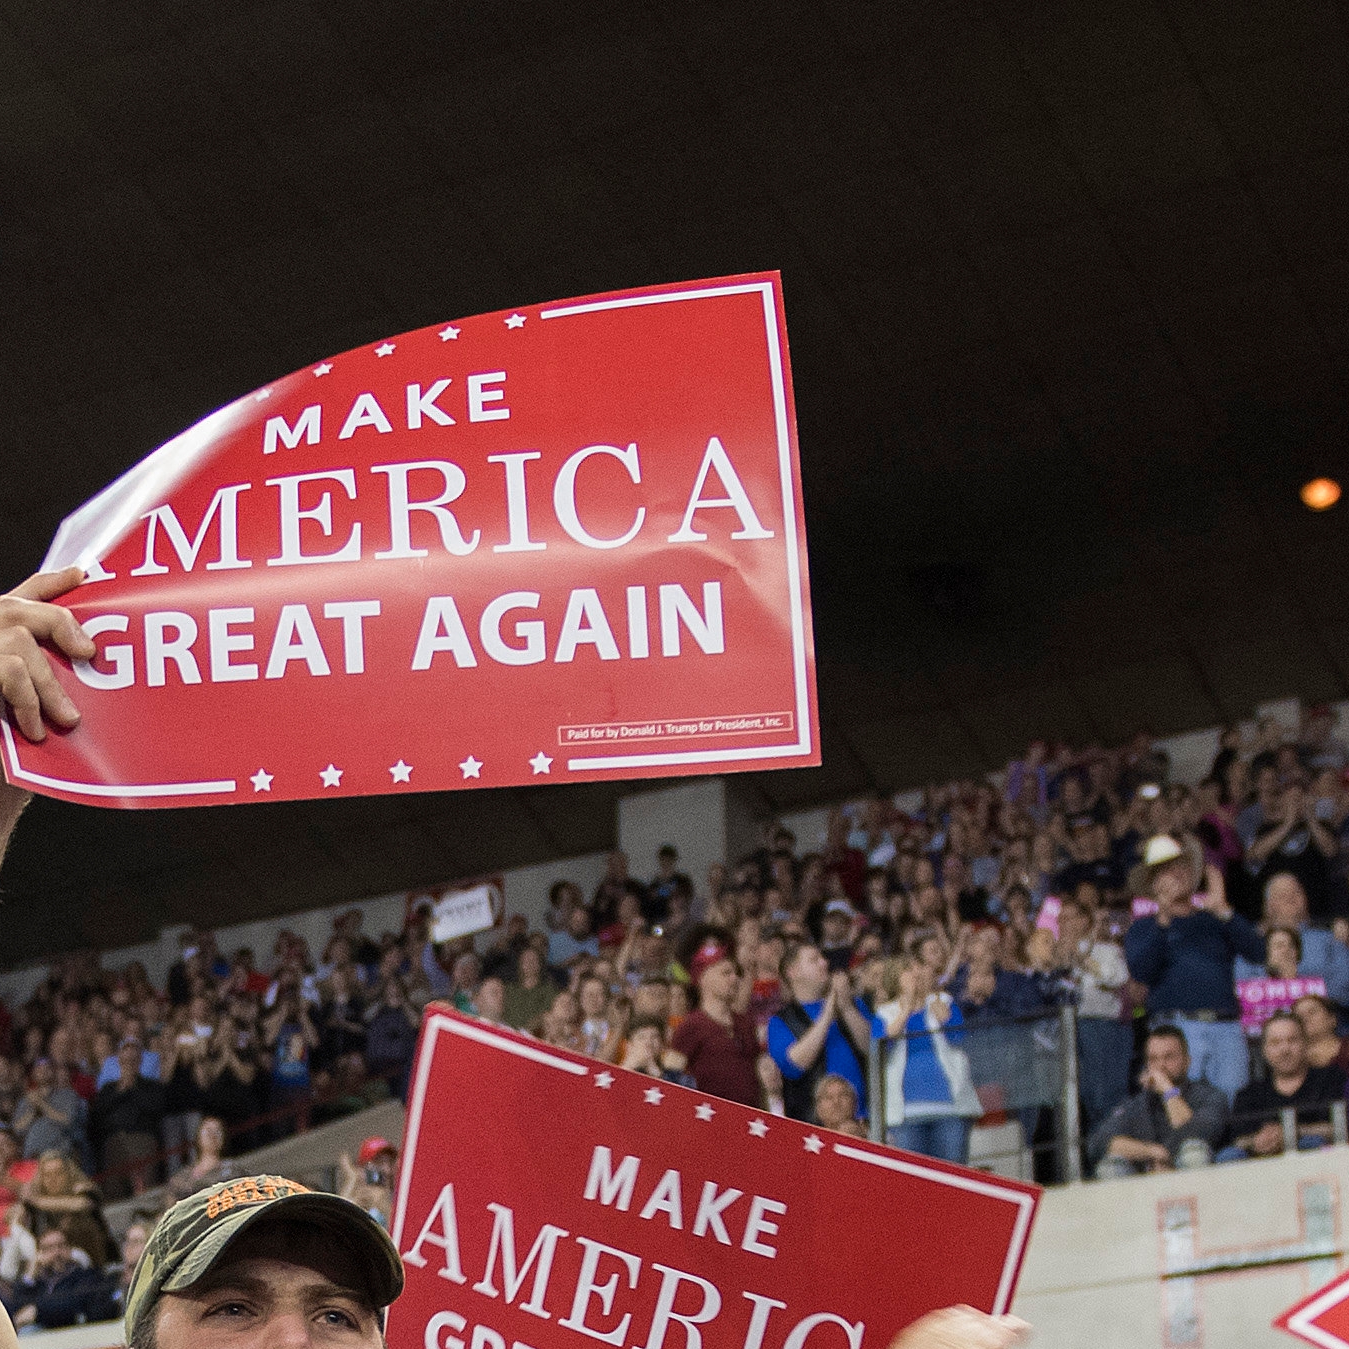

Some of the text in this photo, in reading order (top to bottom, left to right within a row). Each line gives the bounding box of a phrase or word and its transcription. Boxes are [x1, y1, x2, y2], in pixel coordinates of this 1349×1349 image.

[263, 372, 510, 454] MAKE
[73, 581, 725, 691] GREAT AGAIN
[567, 728, 589, 740] Paid
[591, 727, 605, 738] for
[607, 727, 619, 739] by
[620, 724, 655, 737] Donald
[666, 722, 697, 735] Trump
[699, 720, 713, 732] for
[715, 718, 763, 731] President,
[765, 717, 784, 727] Inc.
[1236, 979, 1326, 1002] OMEN
[583, 1145, 787, 1258] MAKE
